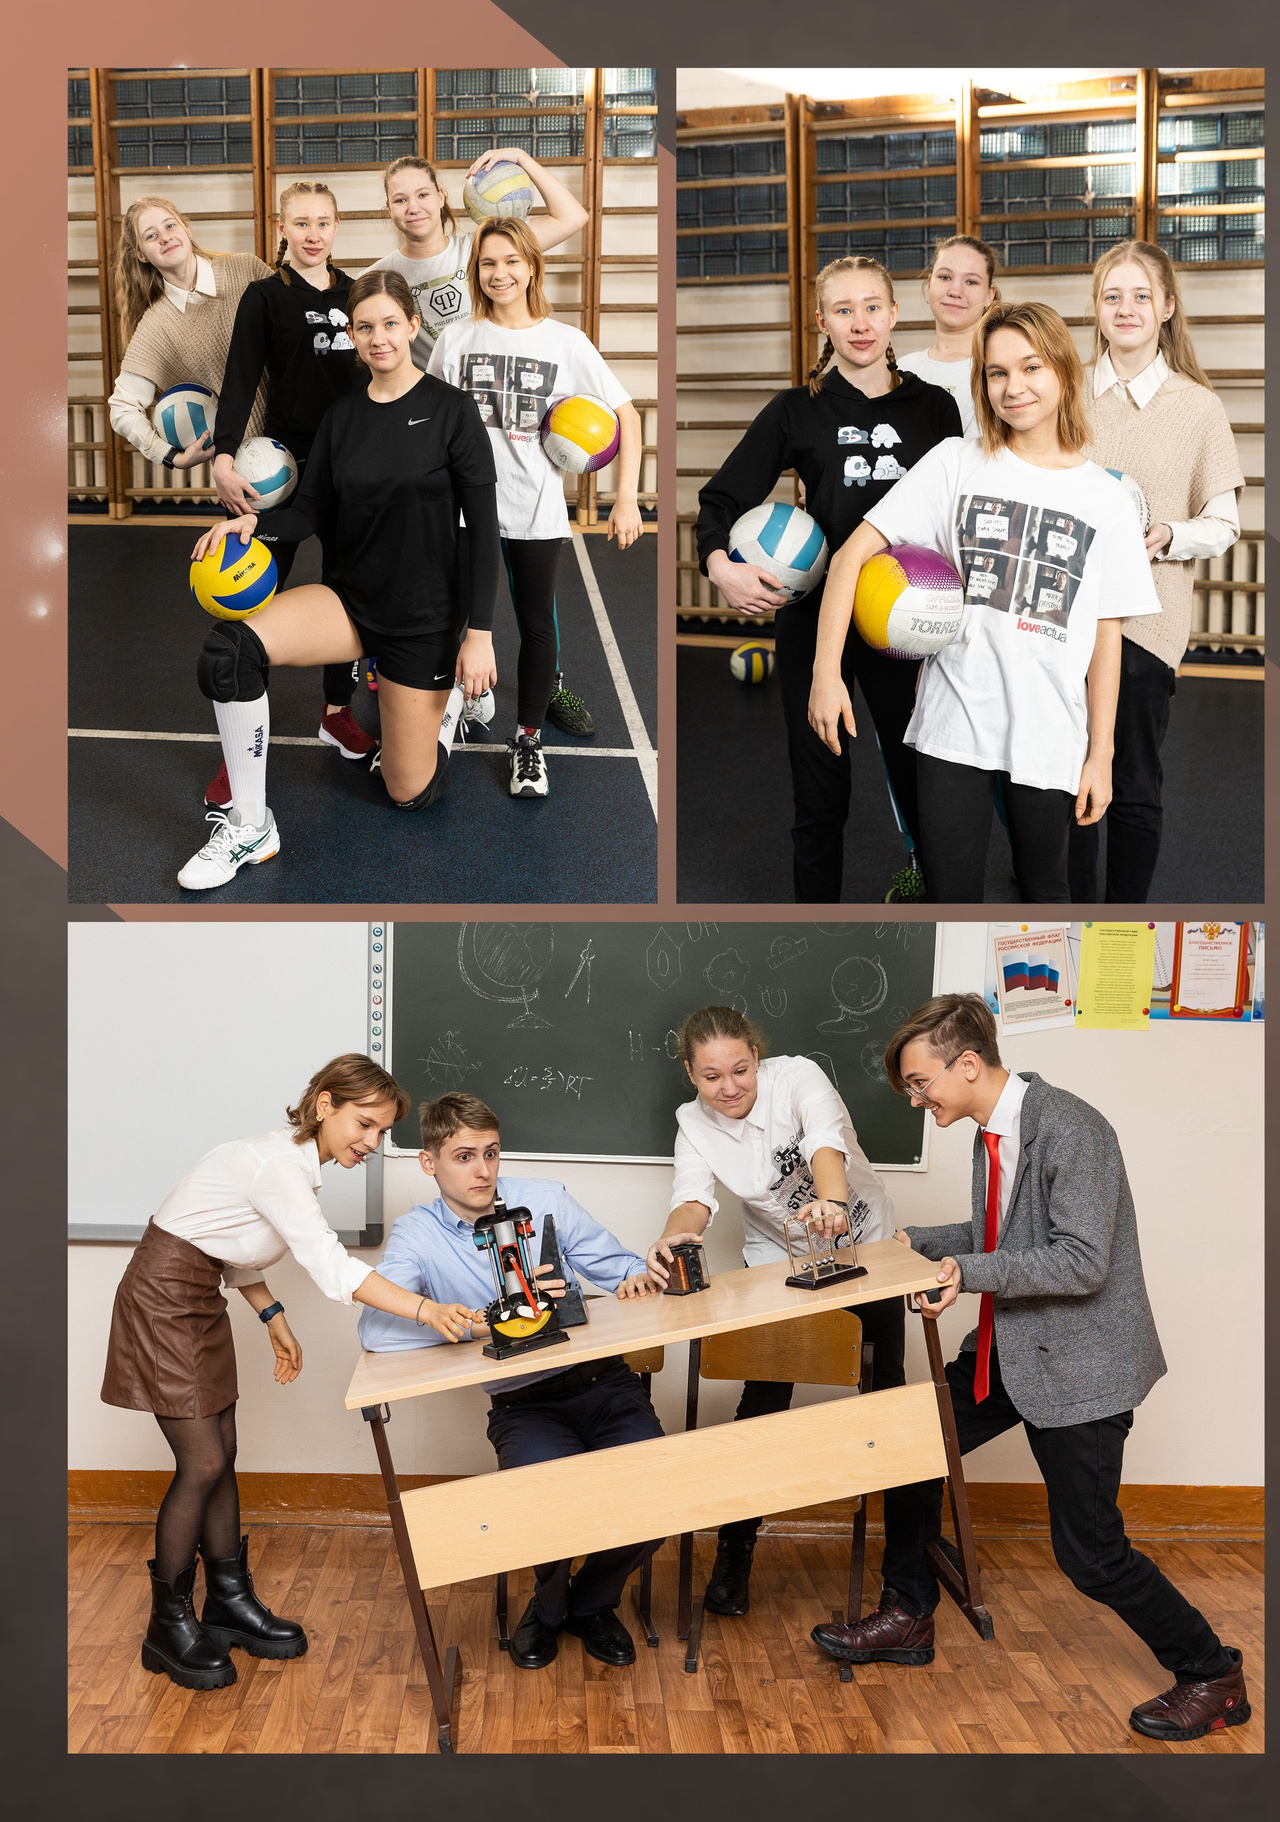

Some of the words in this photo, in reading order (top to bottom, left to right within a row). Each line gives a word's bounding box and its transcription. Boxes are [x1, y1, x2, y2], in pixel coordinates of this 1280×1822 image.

[433, 317, 454, 328] PHILIPP
[997, 935, 1046, 947] ГОСУДАРСТВЕННЫЙ
[997, 942, 1031, 952] РОССИЙСКОЙ
[1031, 938, 1062, 947] ФЕДЕРАЦИИ
